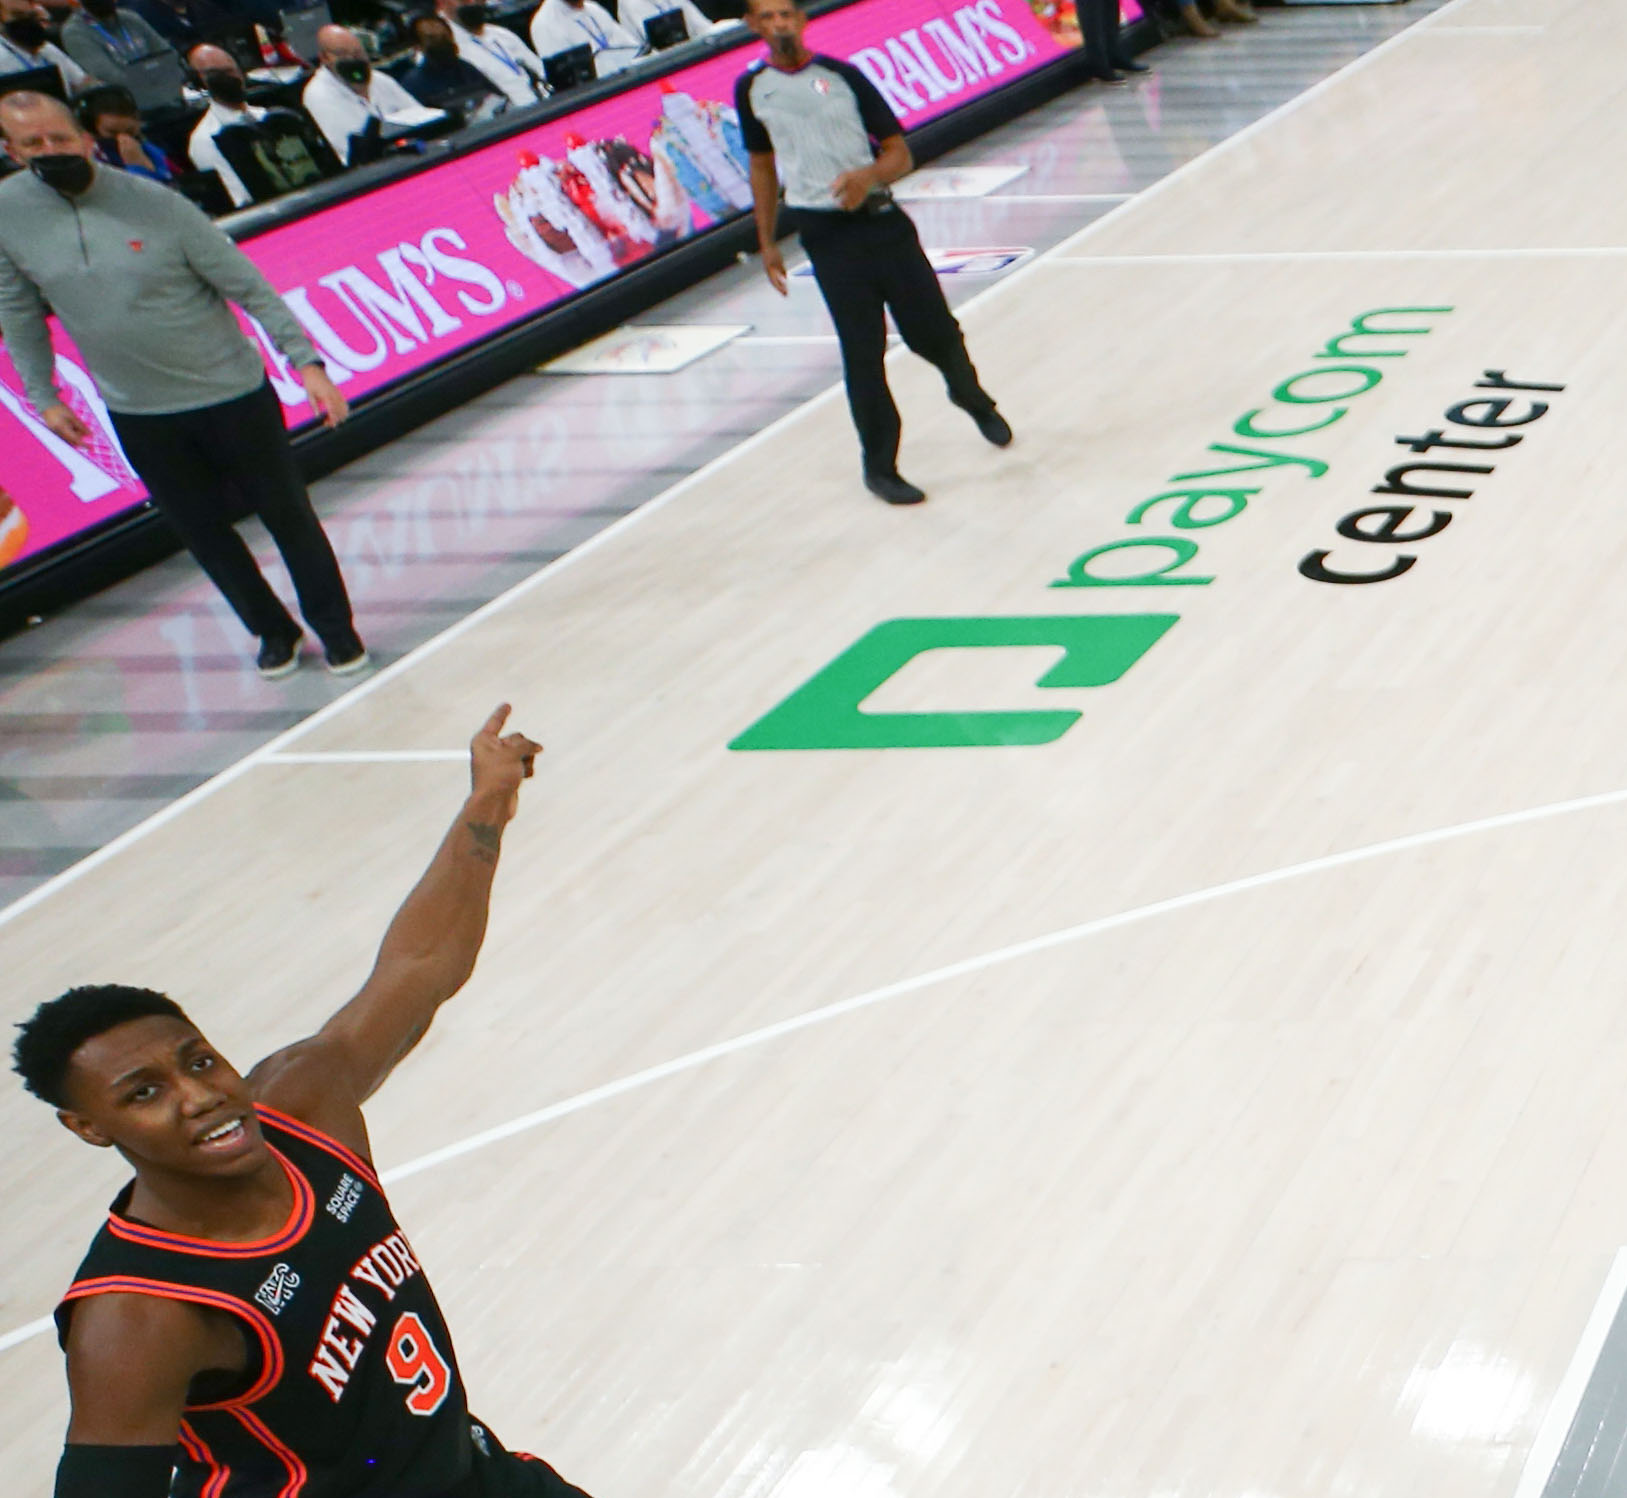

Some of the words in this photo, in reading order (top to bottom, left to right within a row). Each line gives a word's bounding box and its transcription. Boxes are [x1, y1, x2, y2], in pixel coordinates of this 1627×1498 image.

[848, 0, 1027, 118] RAUM'S
[1048, 305, 1454, 587] paycom
[1297, 368, 1567, 584] center
[326, 1173, 354, 1215] SQUARE
[336, 1188, 361, 1223] SPACE
[308, 1282, 378, 1404] NEW
[350, 1228, 421, 1302] YOR
[386, 1311, 452, 1417] 9
